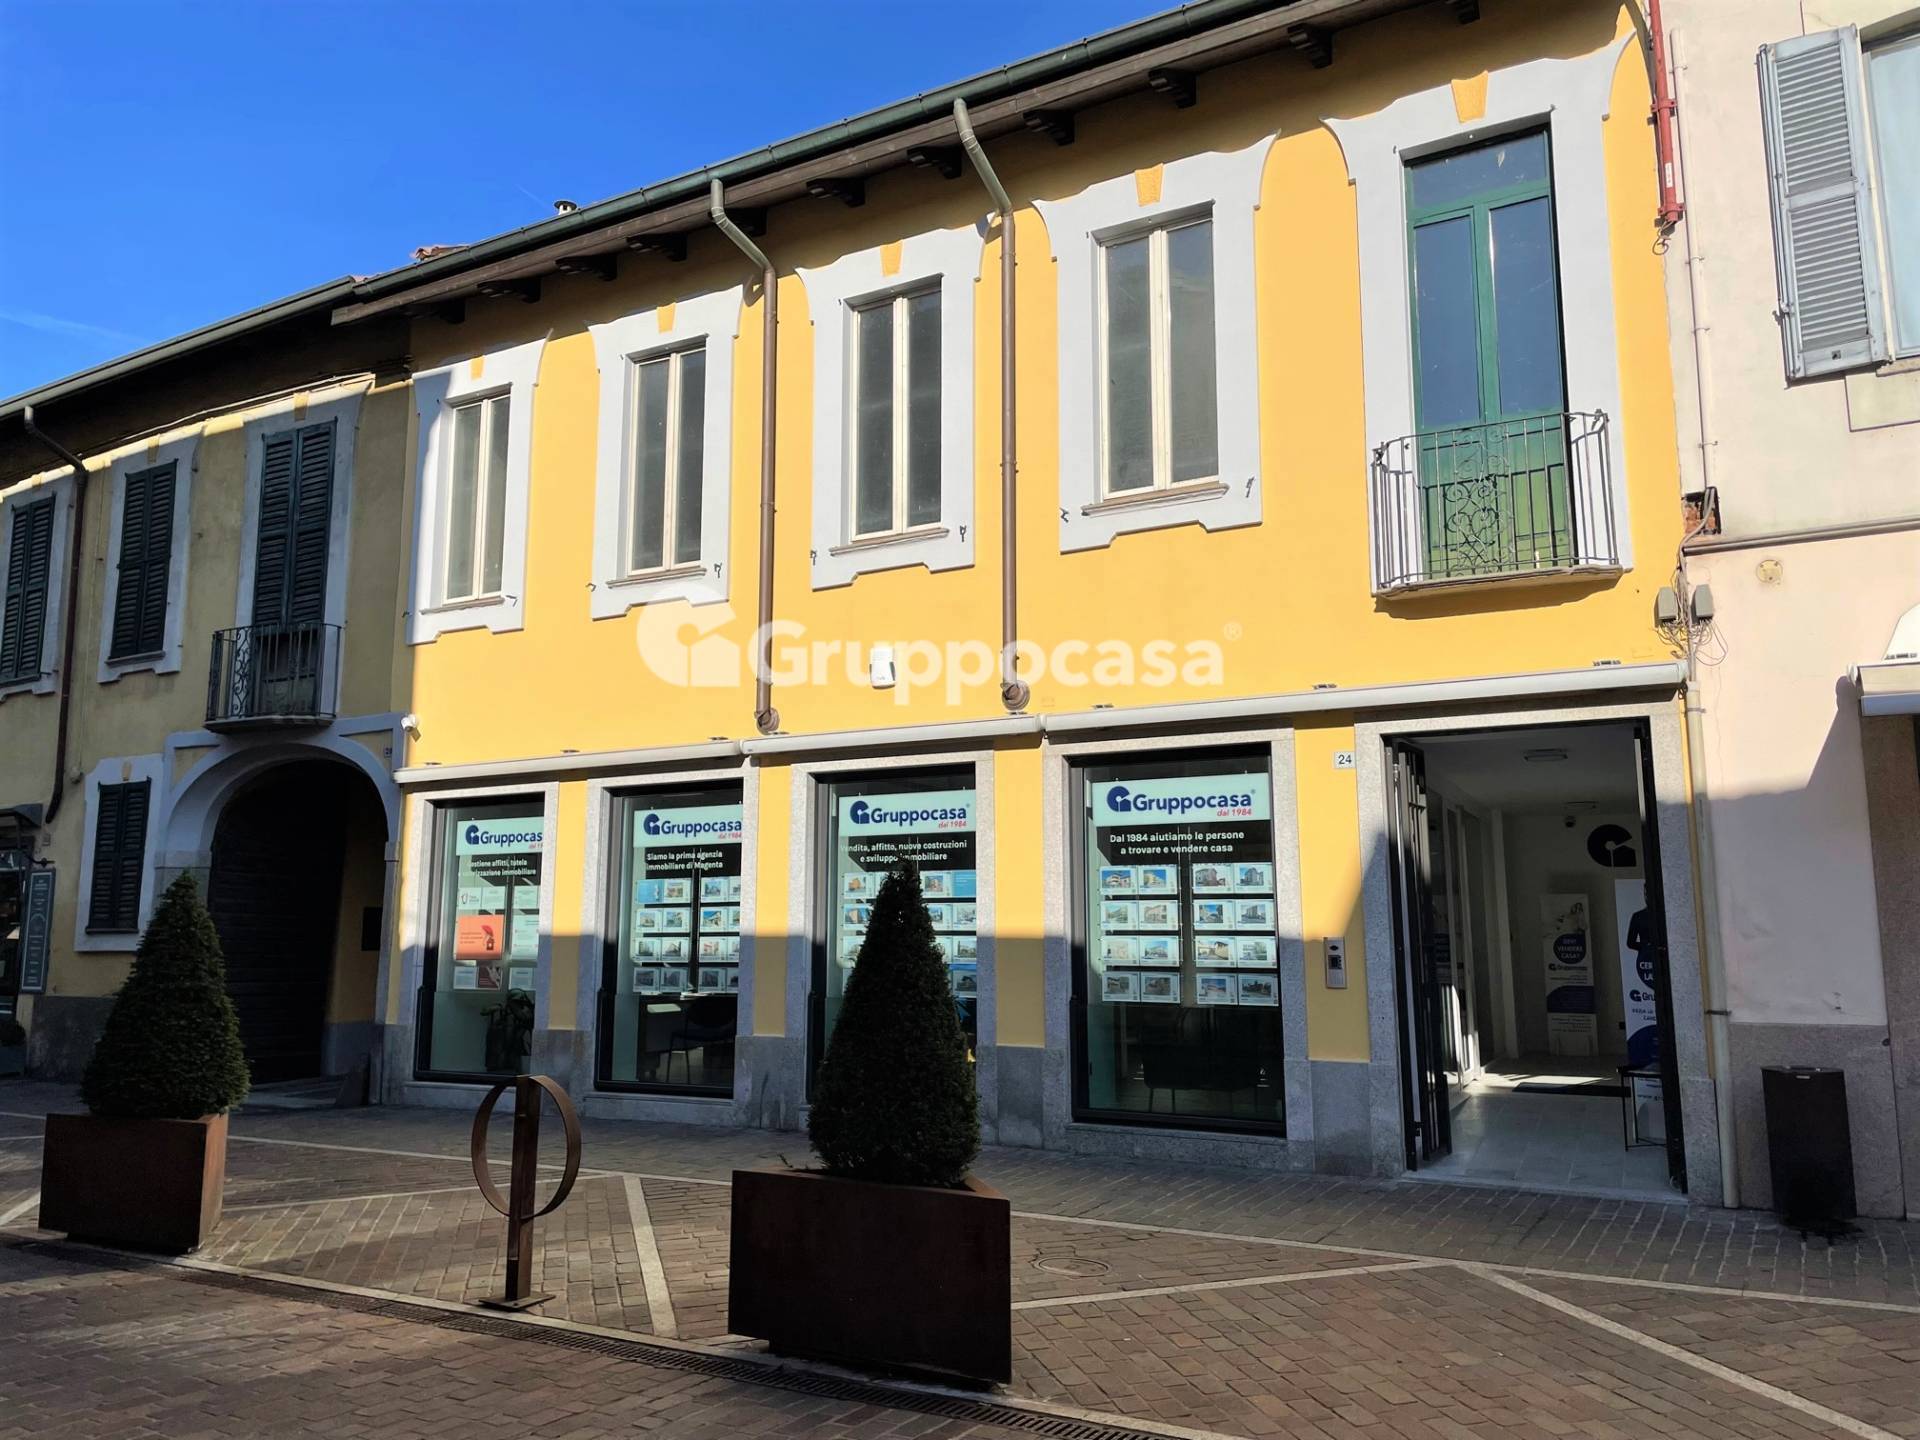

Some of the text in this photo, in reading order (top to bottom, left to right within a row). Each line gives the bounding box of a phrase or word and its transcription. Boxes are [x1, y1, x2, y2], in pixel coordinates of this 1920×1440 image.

[1337, 753, 1353, 766] 24
[1132, 793, 1252, 815] Gruppocasa
[870, 807, 967, 827] Gruppocasa
[1217, 807, 1252, 817] dal 1984
[661, 820, 742, 838] Gruppocasa
[950, 820, 967, 829] 1984
[480, 831, 543, 848] Gruppocas
[1109, 831, 1245, 845] Dal 1984 aiutiamo le persone
[870, 841, 898, 853] affitto,
[922, 839, 968, 851] costruzioni
[1119, 844, 1233, 856] a trovare e vendere casa
[646, 852, 668, 862] Siamo
[675, 851, 695, 862] prima
[469, 860, 491, 869] estione
[646, 862, 685, 872] immobiliare
